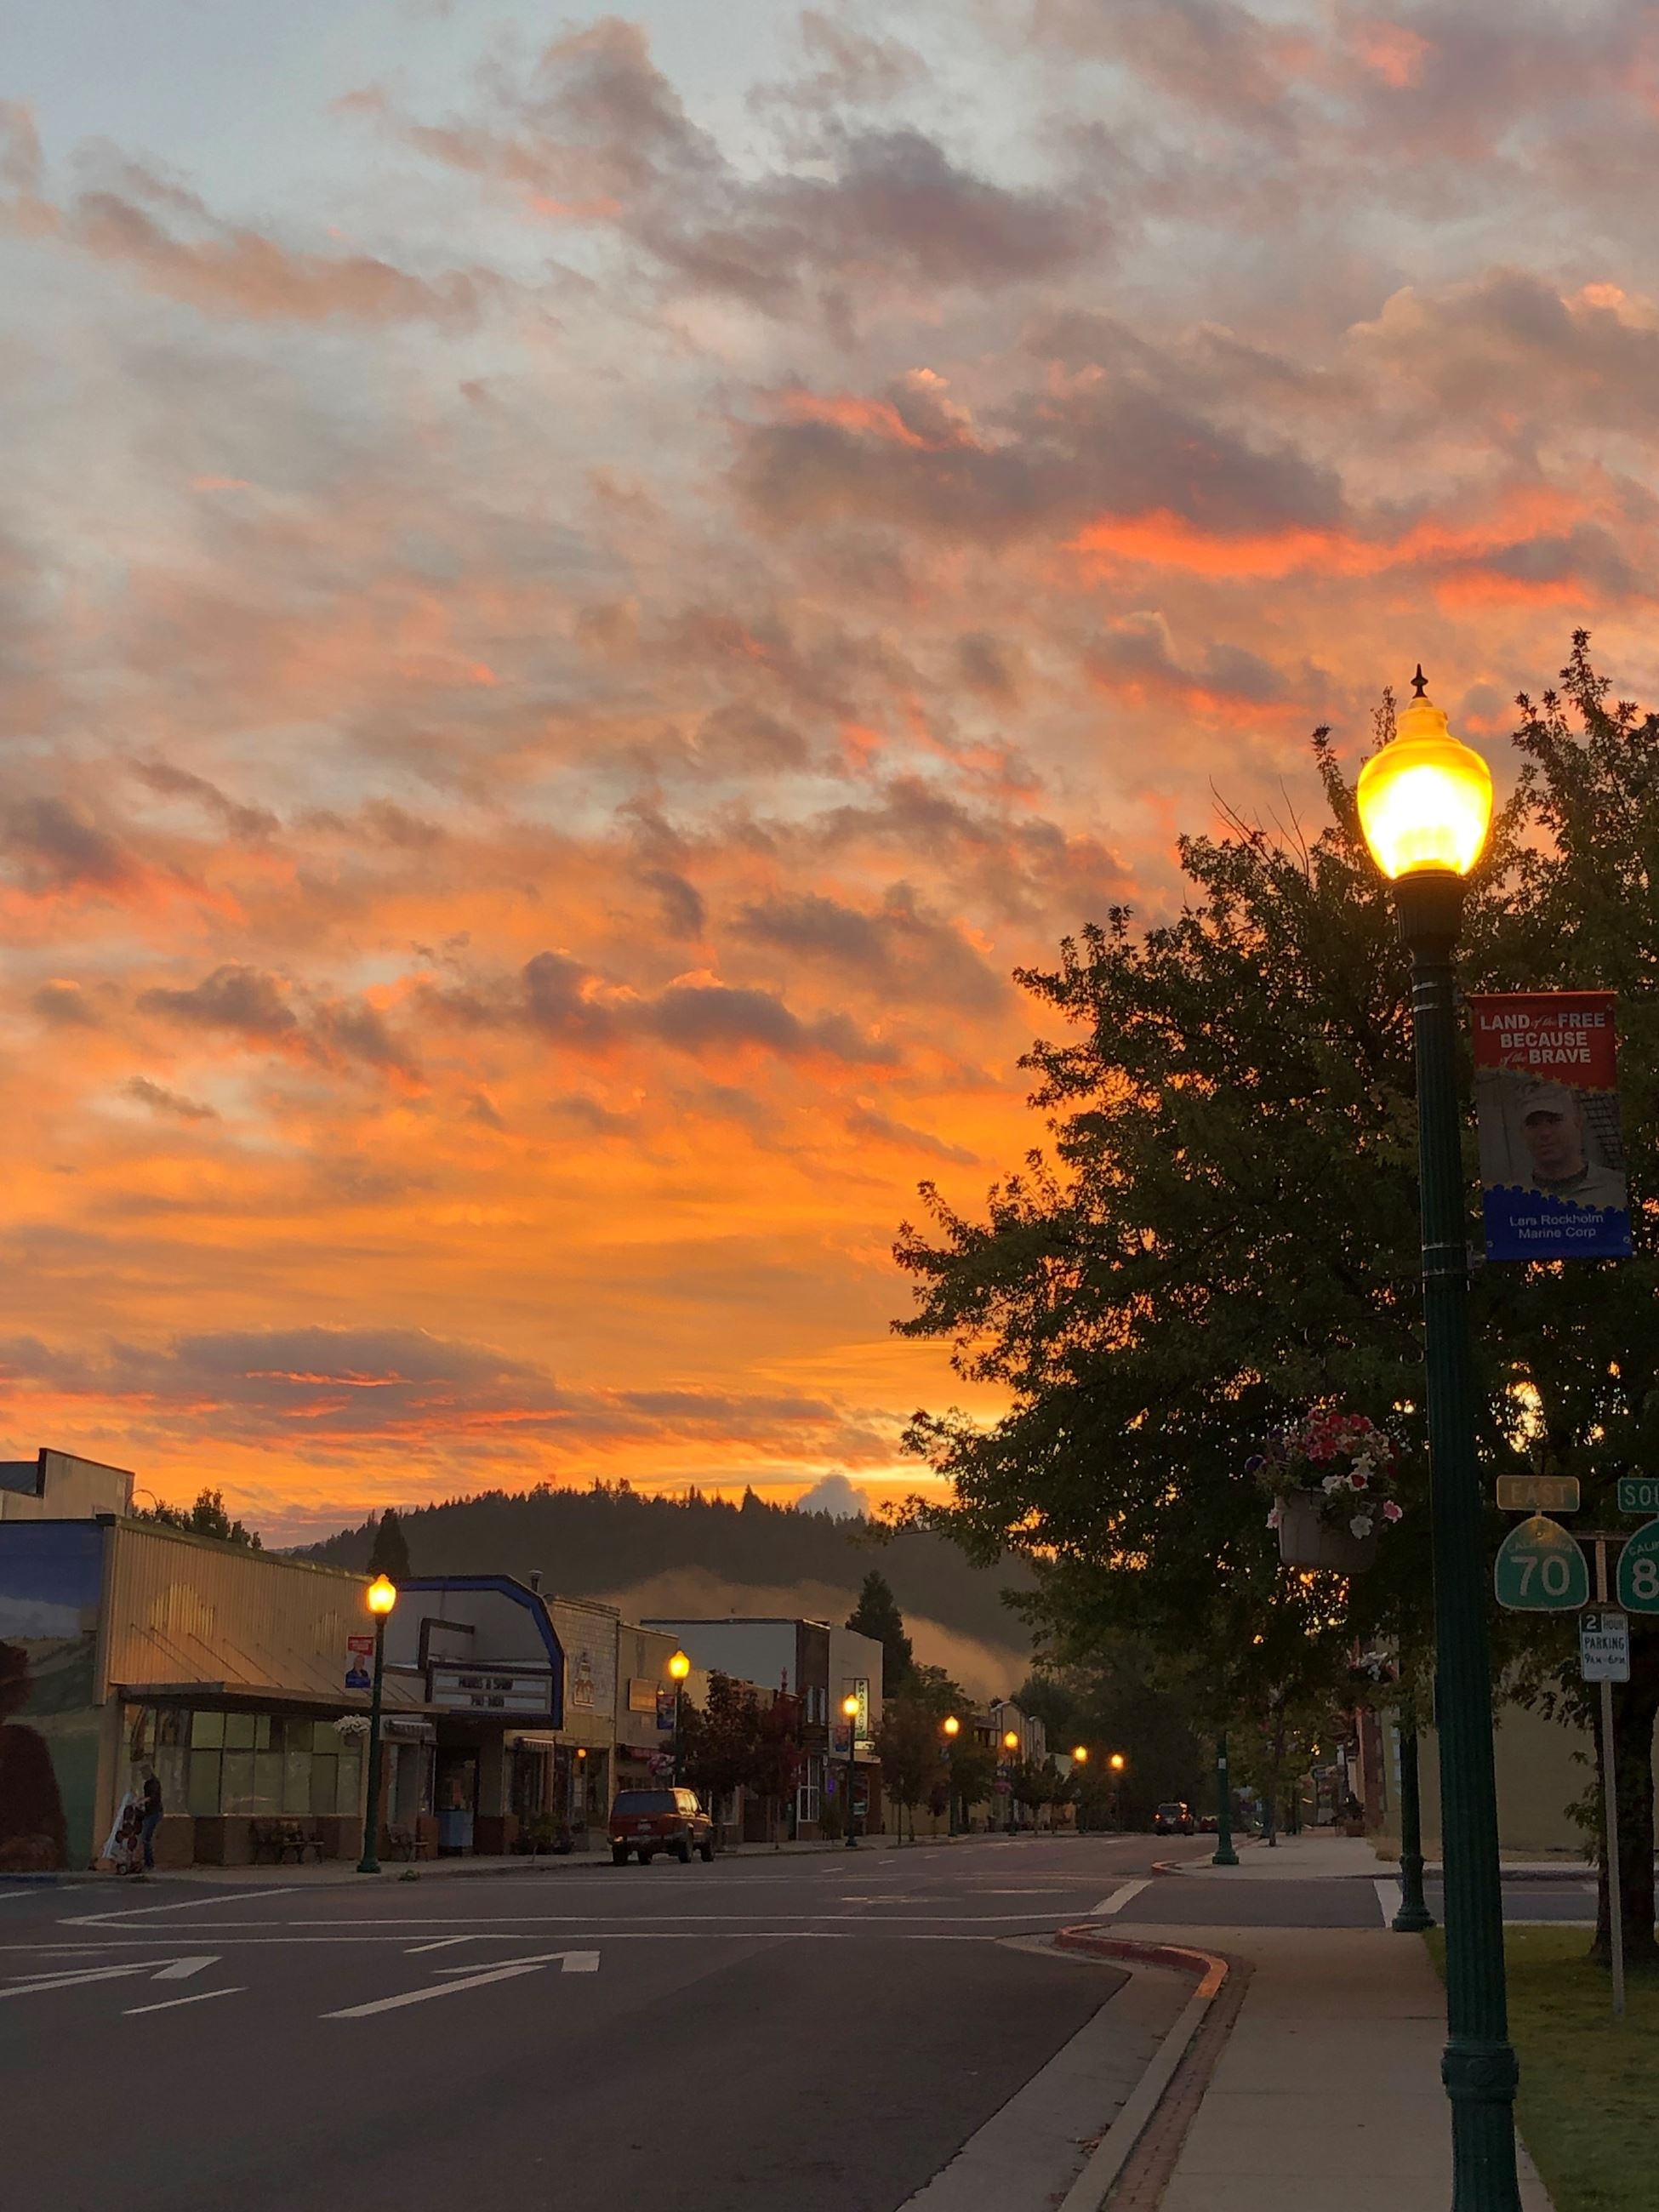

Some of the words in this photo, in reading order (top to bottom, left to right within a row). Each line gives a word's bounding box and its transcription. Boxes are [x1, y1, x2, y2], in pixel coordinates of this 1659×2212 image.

[1480, 1014, 1530, 1030] LAND
[1558, 1012, 1605, 1029] FREE
[1500, 1031, 1588, 1048] BECAUSE
[1529, 1048, 1591, 1064] BRAVE
[1509, 1215, 1537, 1228] Lars
[1541, 1213, 1604, 1227] Rockholm
[1519, 1228, 1561, 1240] Marine
[1565, 1226, 1597, 1239] Corp
[1511, 1483, 1567, 1504] EAST
[1510, 1555, 1571, 1596] 70
[1586, 1614, 1597, 1629] 2
[1585, 1637, 1625, 1650] PARKING
